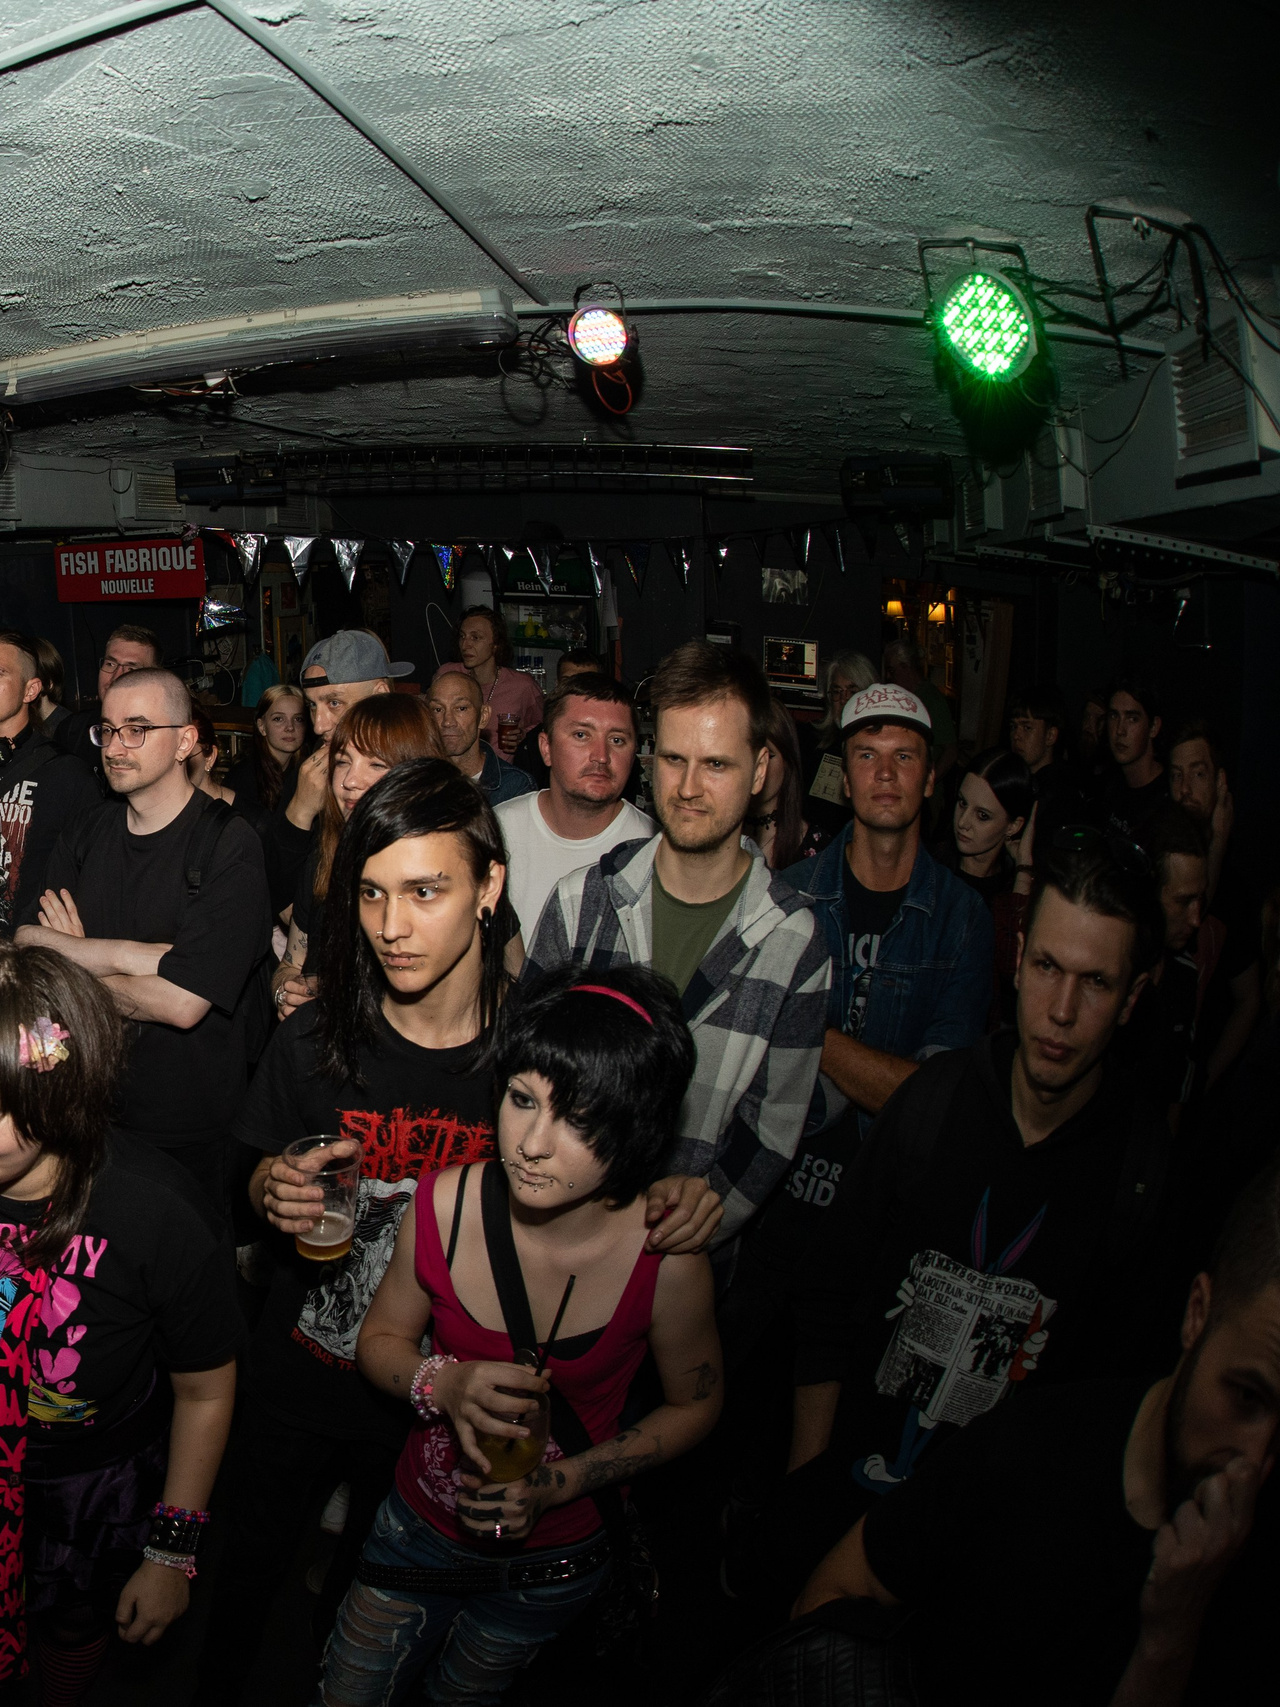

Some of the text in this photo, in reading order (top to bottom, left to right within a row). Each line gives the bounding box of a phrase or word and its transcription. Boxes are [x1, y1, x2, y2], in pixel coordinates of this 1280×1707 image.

[60, 545, 197, 576] FISH FABRIQUE
[101, 578, 155, 594] NOUVELLE
[517, 581, 567, 592] Heinen
[800, 1152, 843, 1182] FOR
[922, 1274, 945, 1292] ABOUT
[966, 1291, 981, 1306] SKY
[966, 1272, 978, 1284] OF
[977, 1278, 993, 1291] THE
[995, 1282, 1035, 1300] WORLD
[290, 1327, 337, 1368] BECOME
